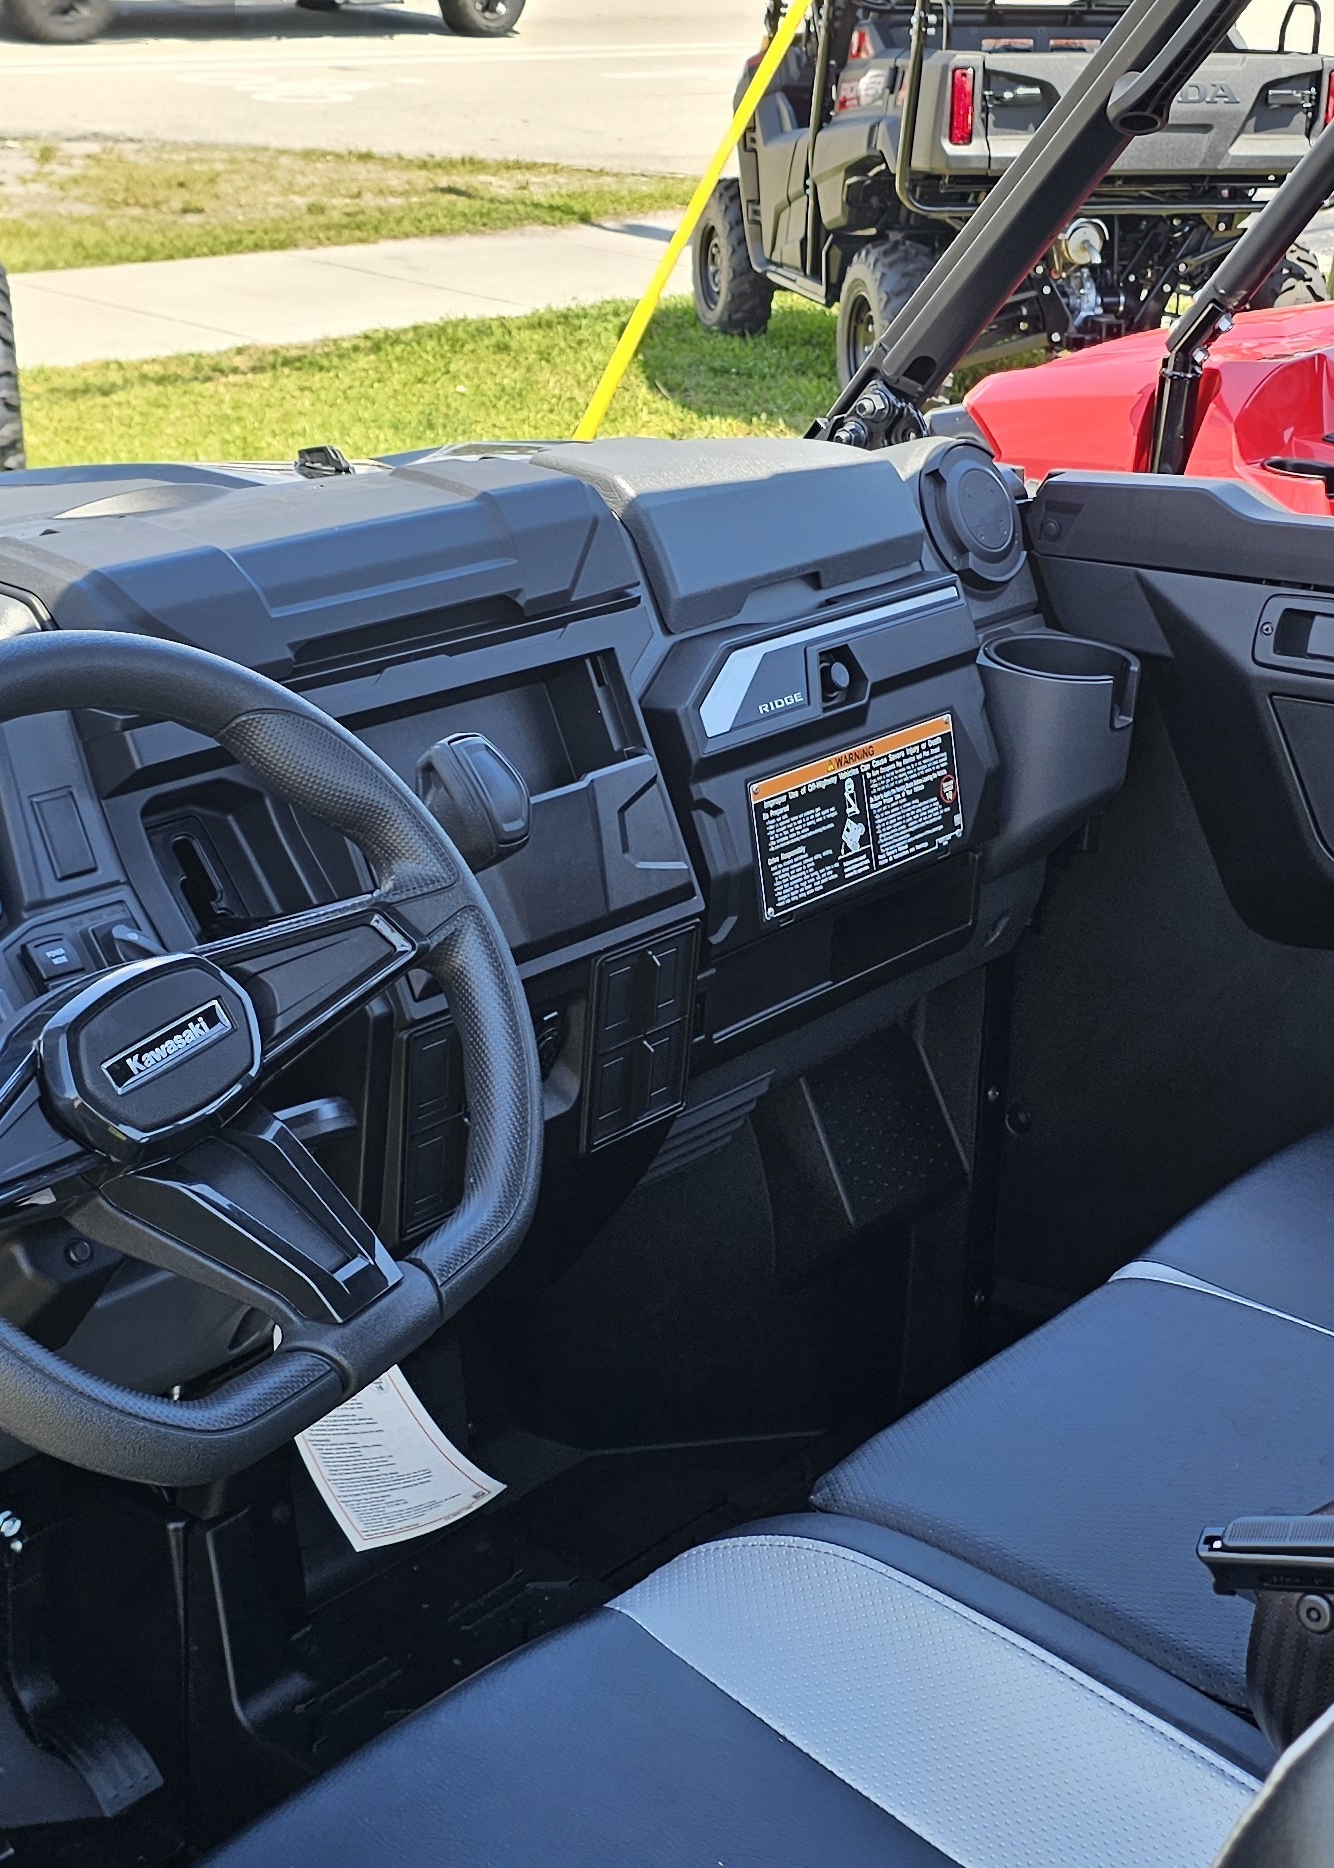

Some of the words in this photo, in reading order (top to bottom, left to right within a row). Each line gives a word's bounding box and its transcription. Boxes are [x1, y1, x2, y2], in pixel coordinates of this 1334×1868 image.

[758, 692, 804, 714] RIDGE
[834, 746, 875, 768] WARNING
[125, 1016, 210, 1075] Kawasaki
